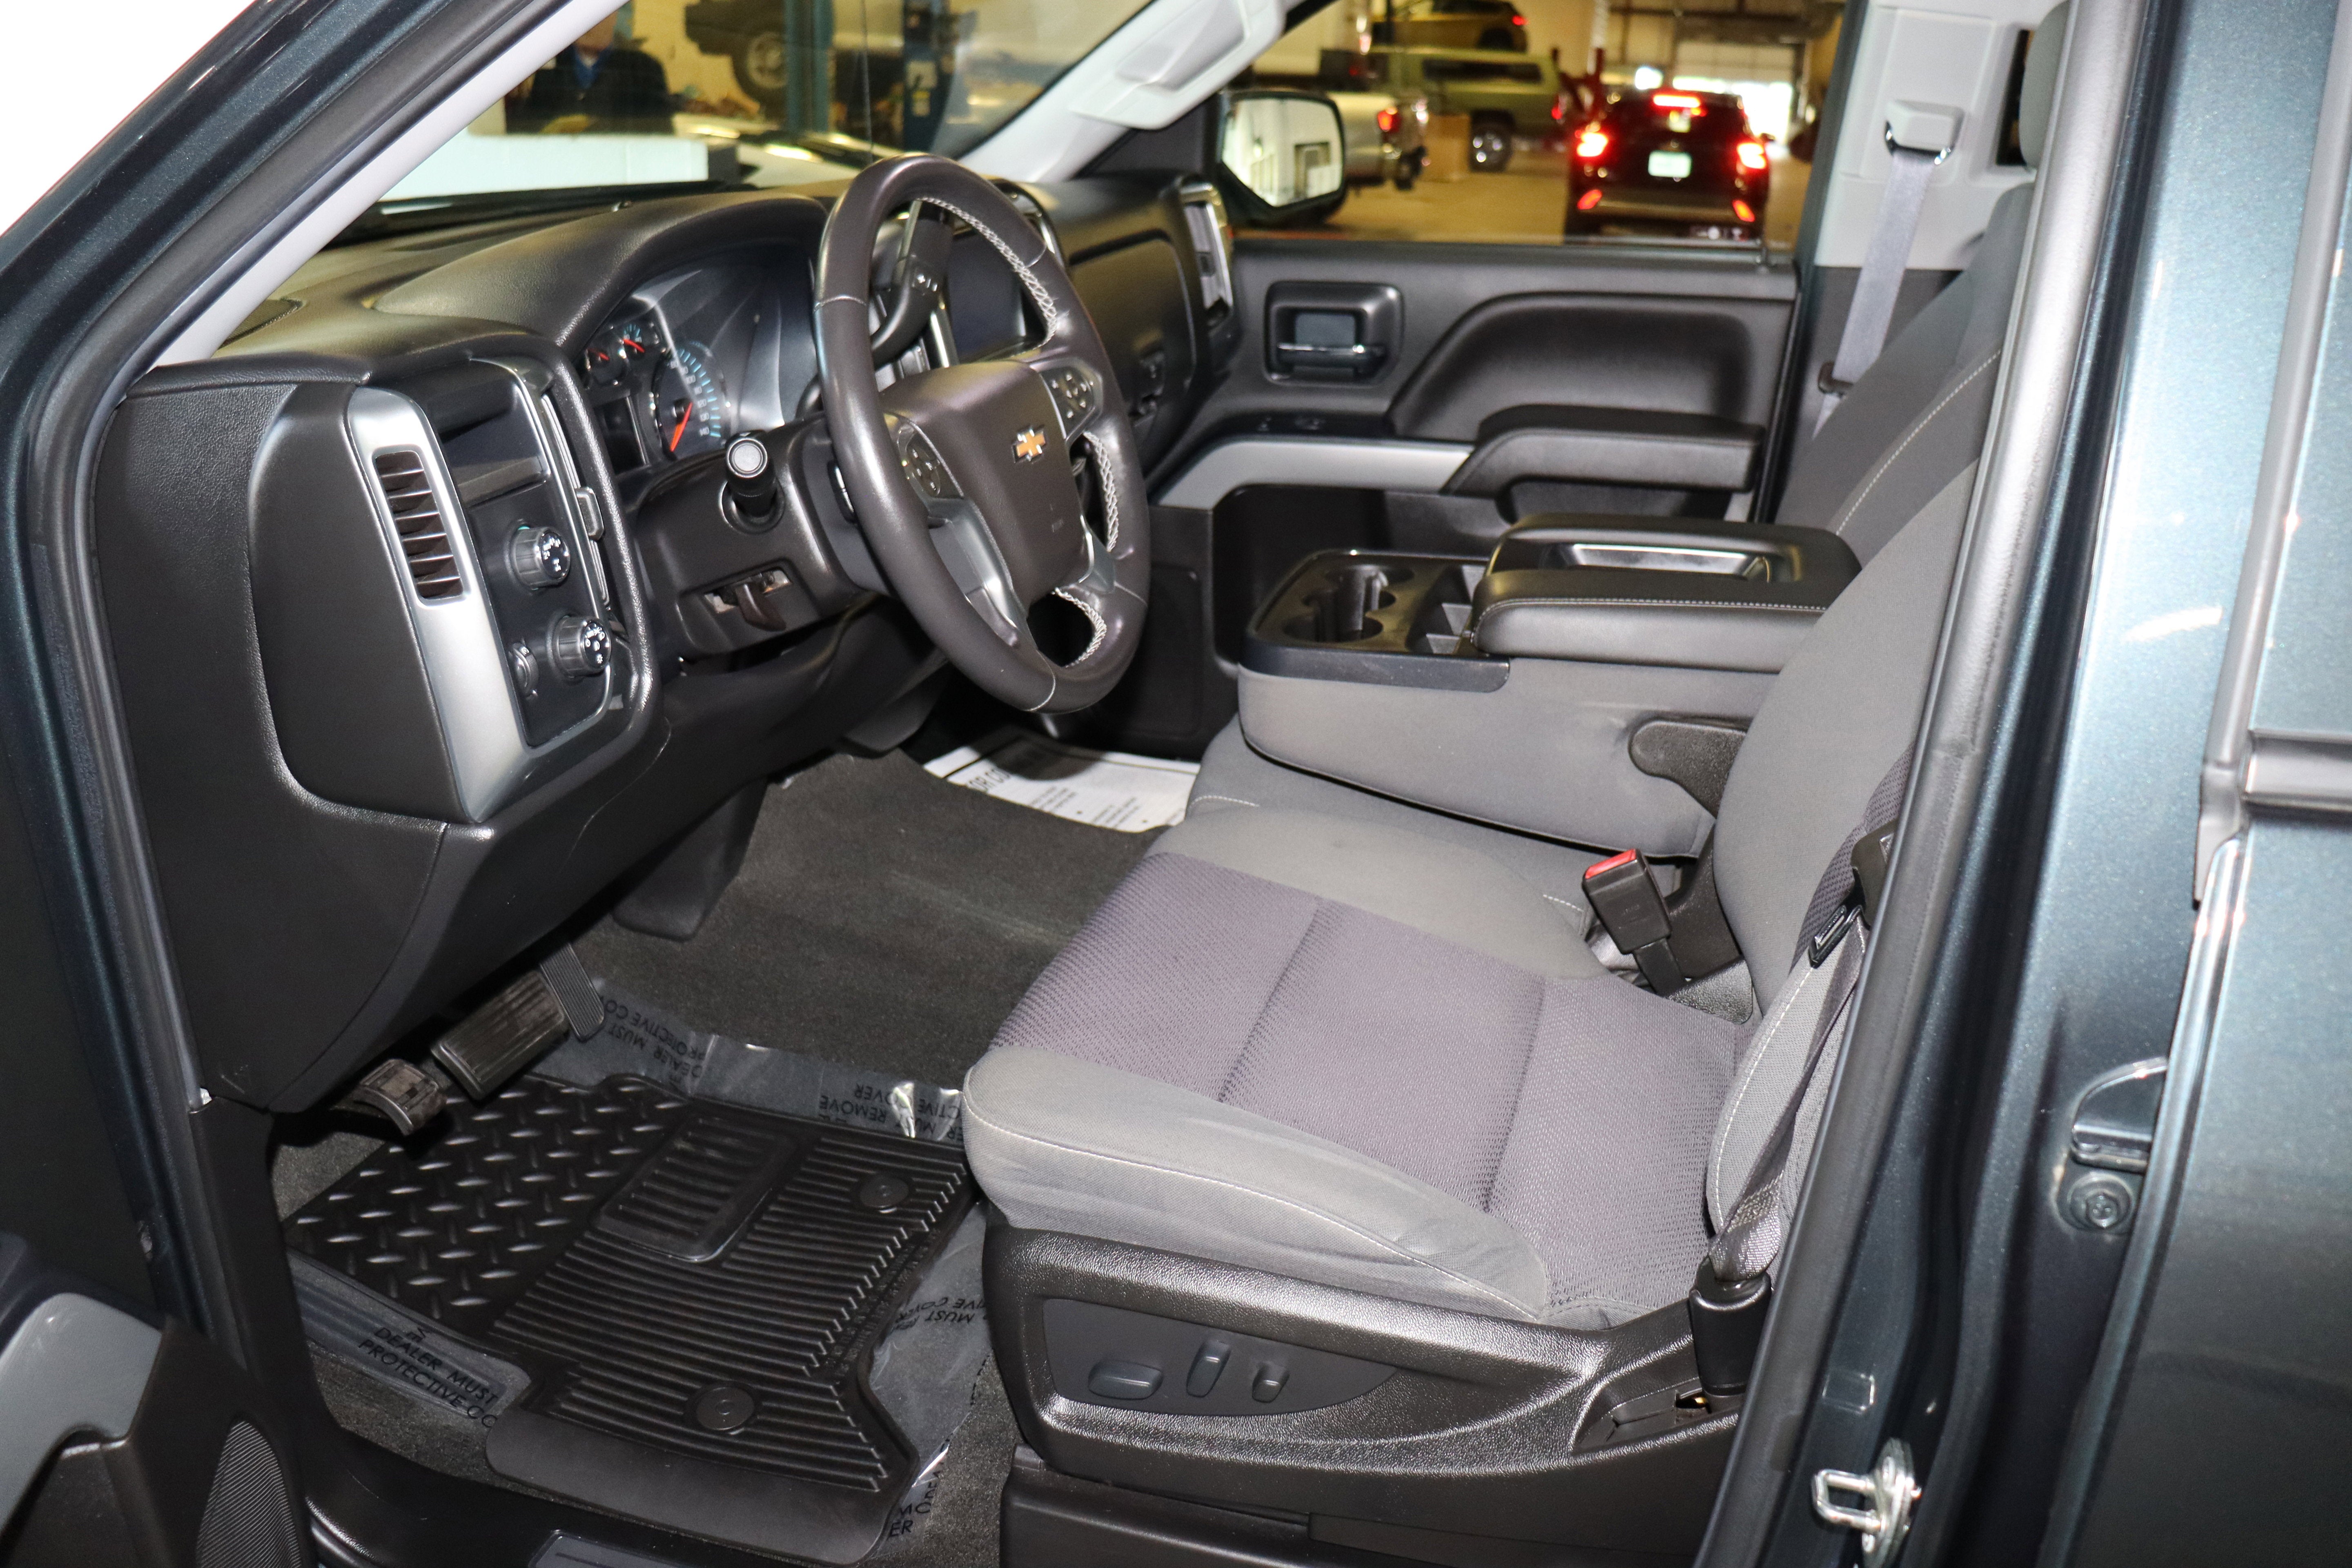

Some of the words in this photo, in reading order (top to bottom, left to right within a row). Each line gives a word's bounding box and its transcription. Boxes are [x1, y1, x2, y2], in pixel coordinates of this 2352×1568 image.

[697, 399, 707, 409] 120
[699, 412, 710, 422] 130
[699, 427, 710, 437] 140
[608, 1023, 647, 1050] MUST
[819, 1096, 886, 1124] REMOVE
[924, 1310, 975, 1325] MUST
[358, 1339, 466, 1407] PROTECTIVE
[374, 1327, 443, 1370] DEALER
[446, 1370, 499, 1404] MUST
